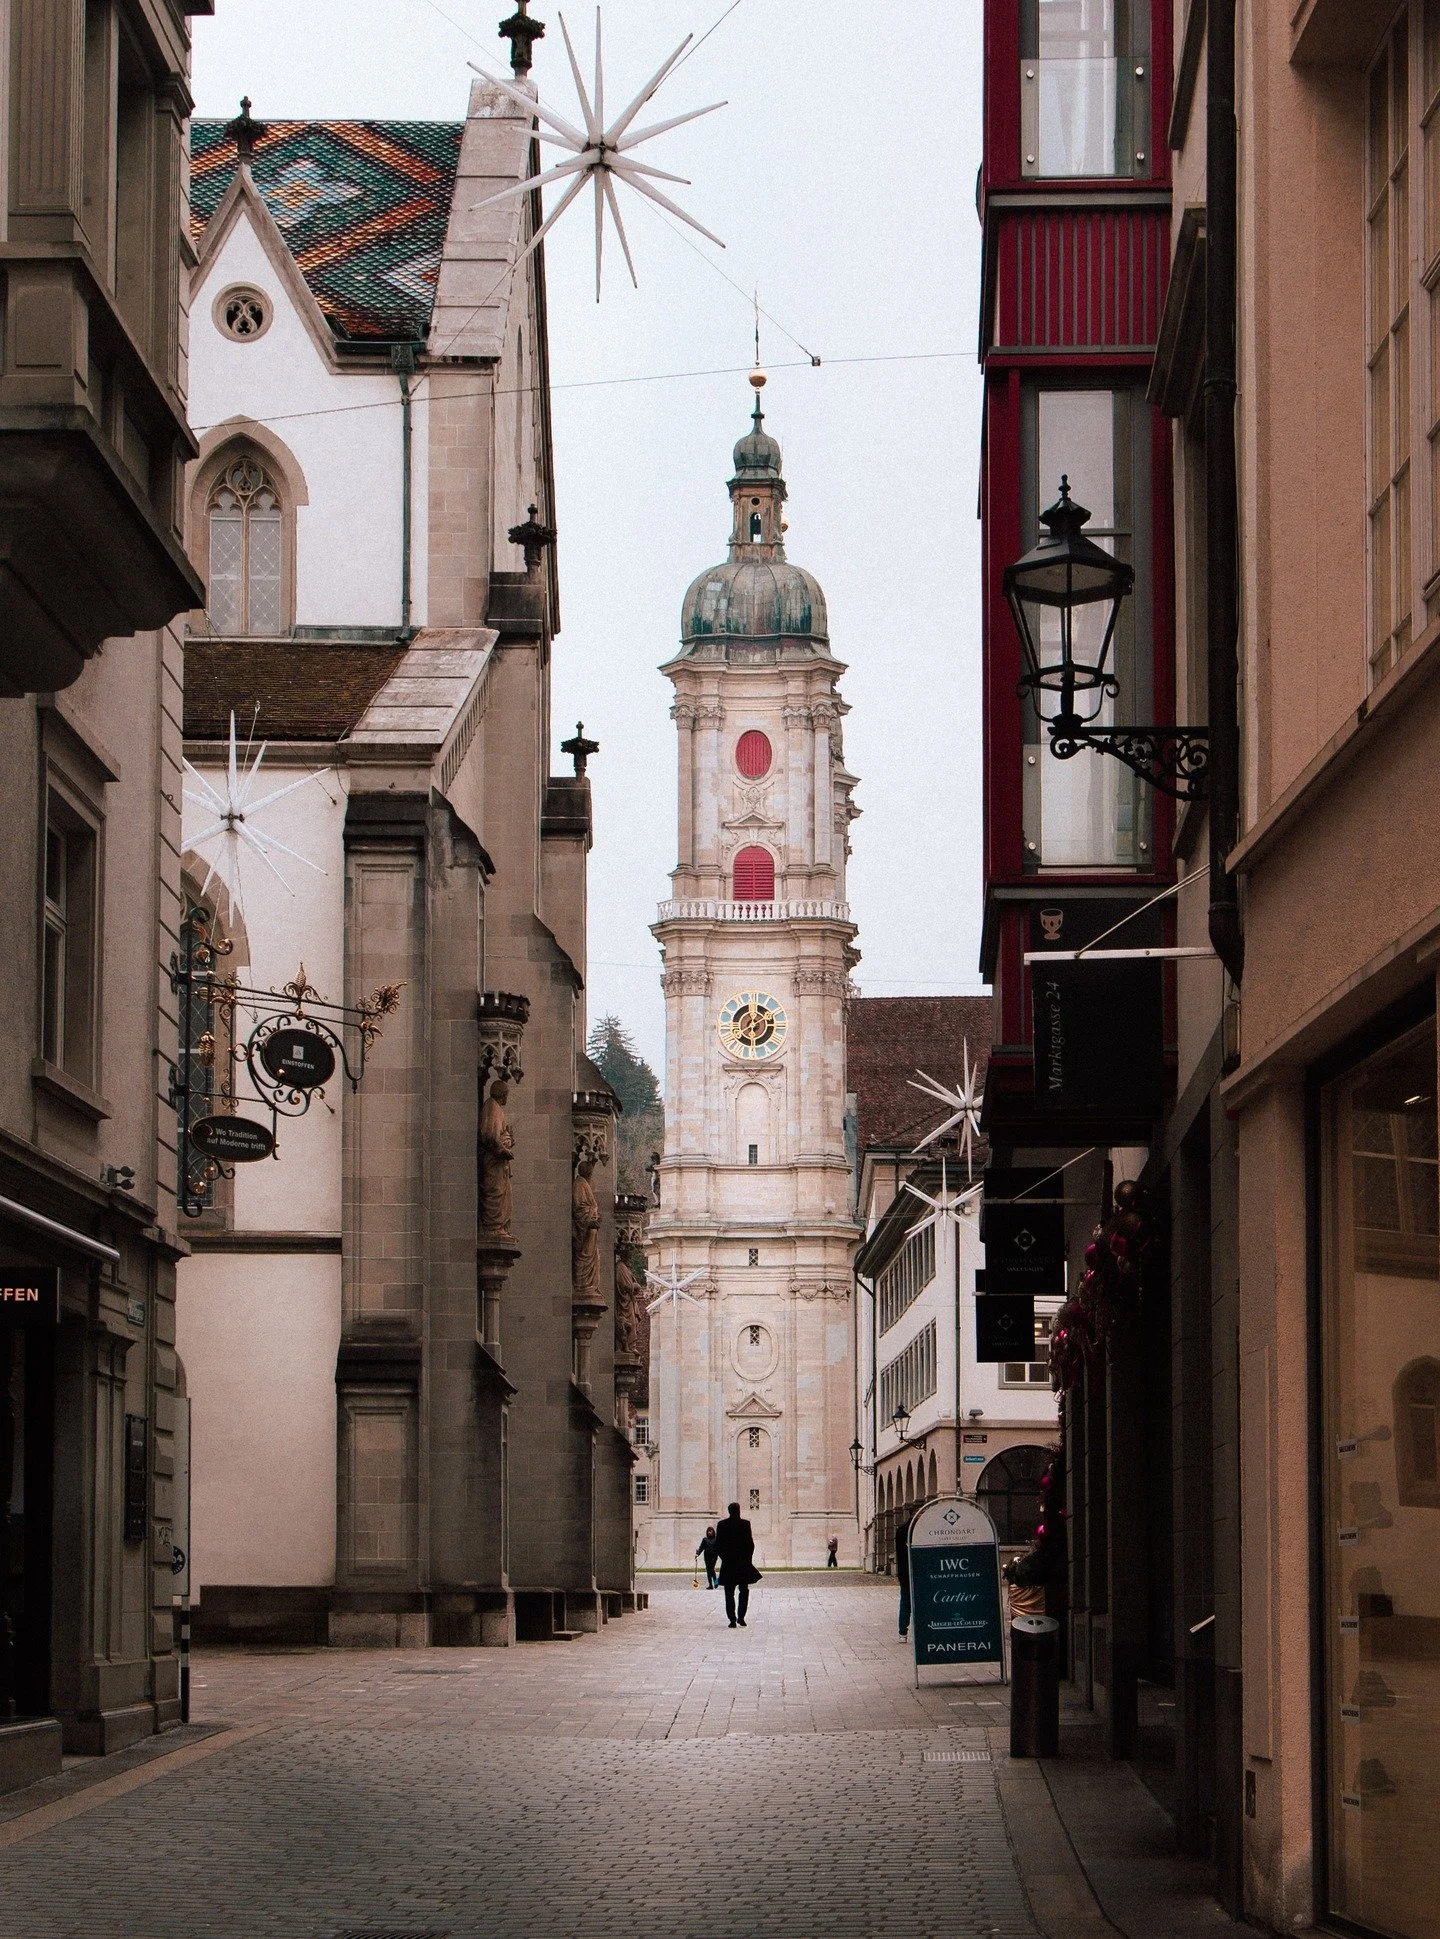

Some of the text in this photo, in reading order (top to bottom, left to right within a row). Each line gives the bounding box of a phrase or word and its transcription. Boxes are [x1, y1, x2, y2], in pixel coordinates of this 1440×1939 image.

[1046, 979, 1065, 1090] Marktgasse 24
[282, 1058, 315, 1070] EINSTOFFEN
[216, 1128, 258, 1140] Wo Tradition
[219, 1138, 249, 1148] Moderne
[928, 1528, 975, 1536] CHRONOART
[940, 1558, 969, 1571] IWC
[933, 1589, 979, 1603] Cartier
[927, 1641, 991, 1652] PANERAI
